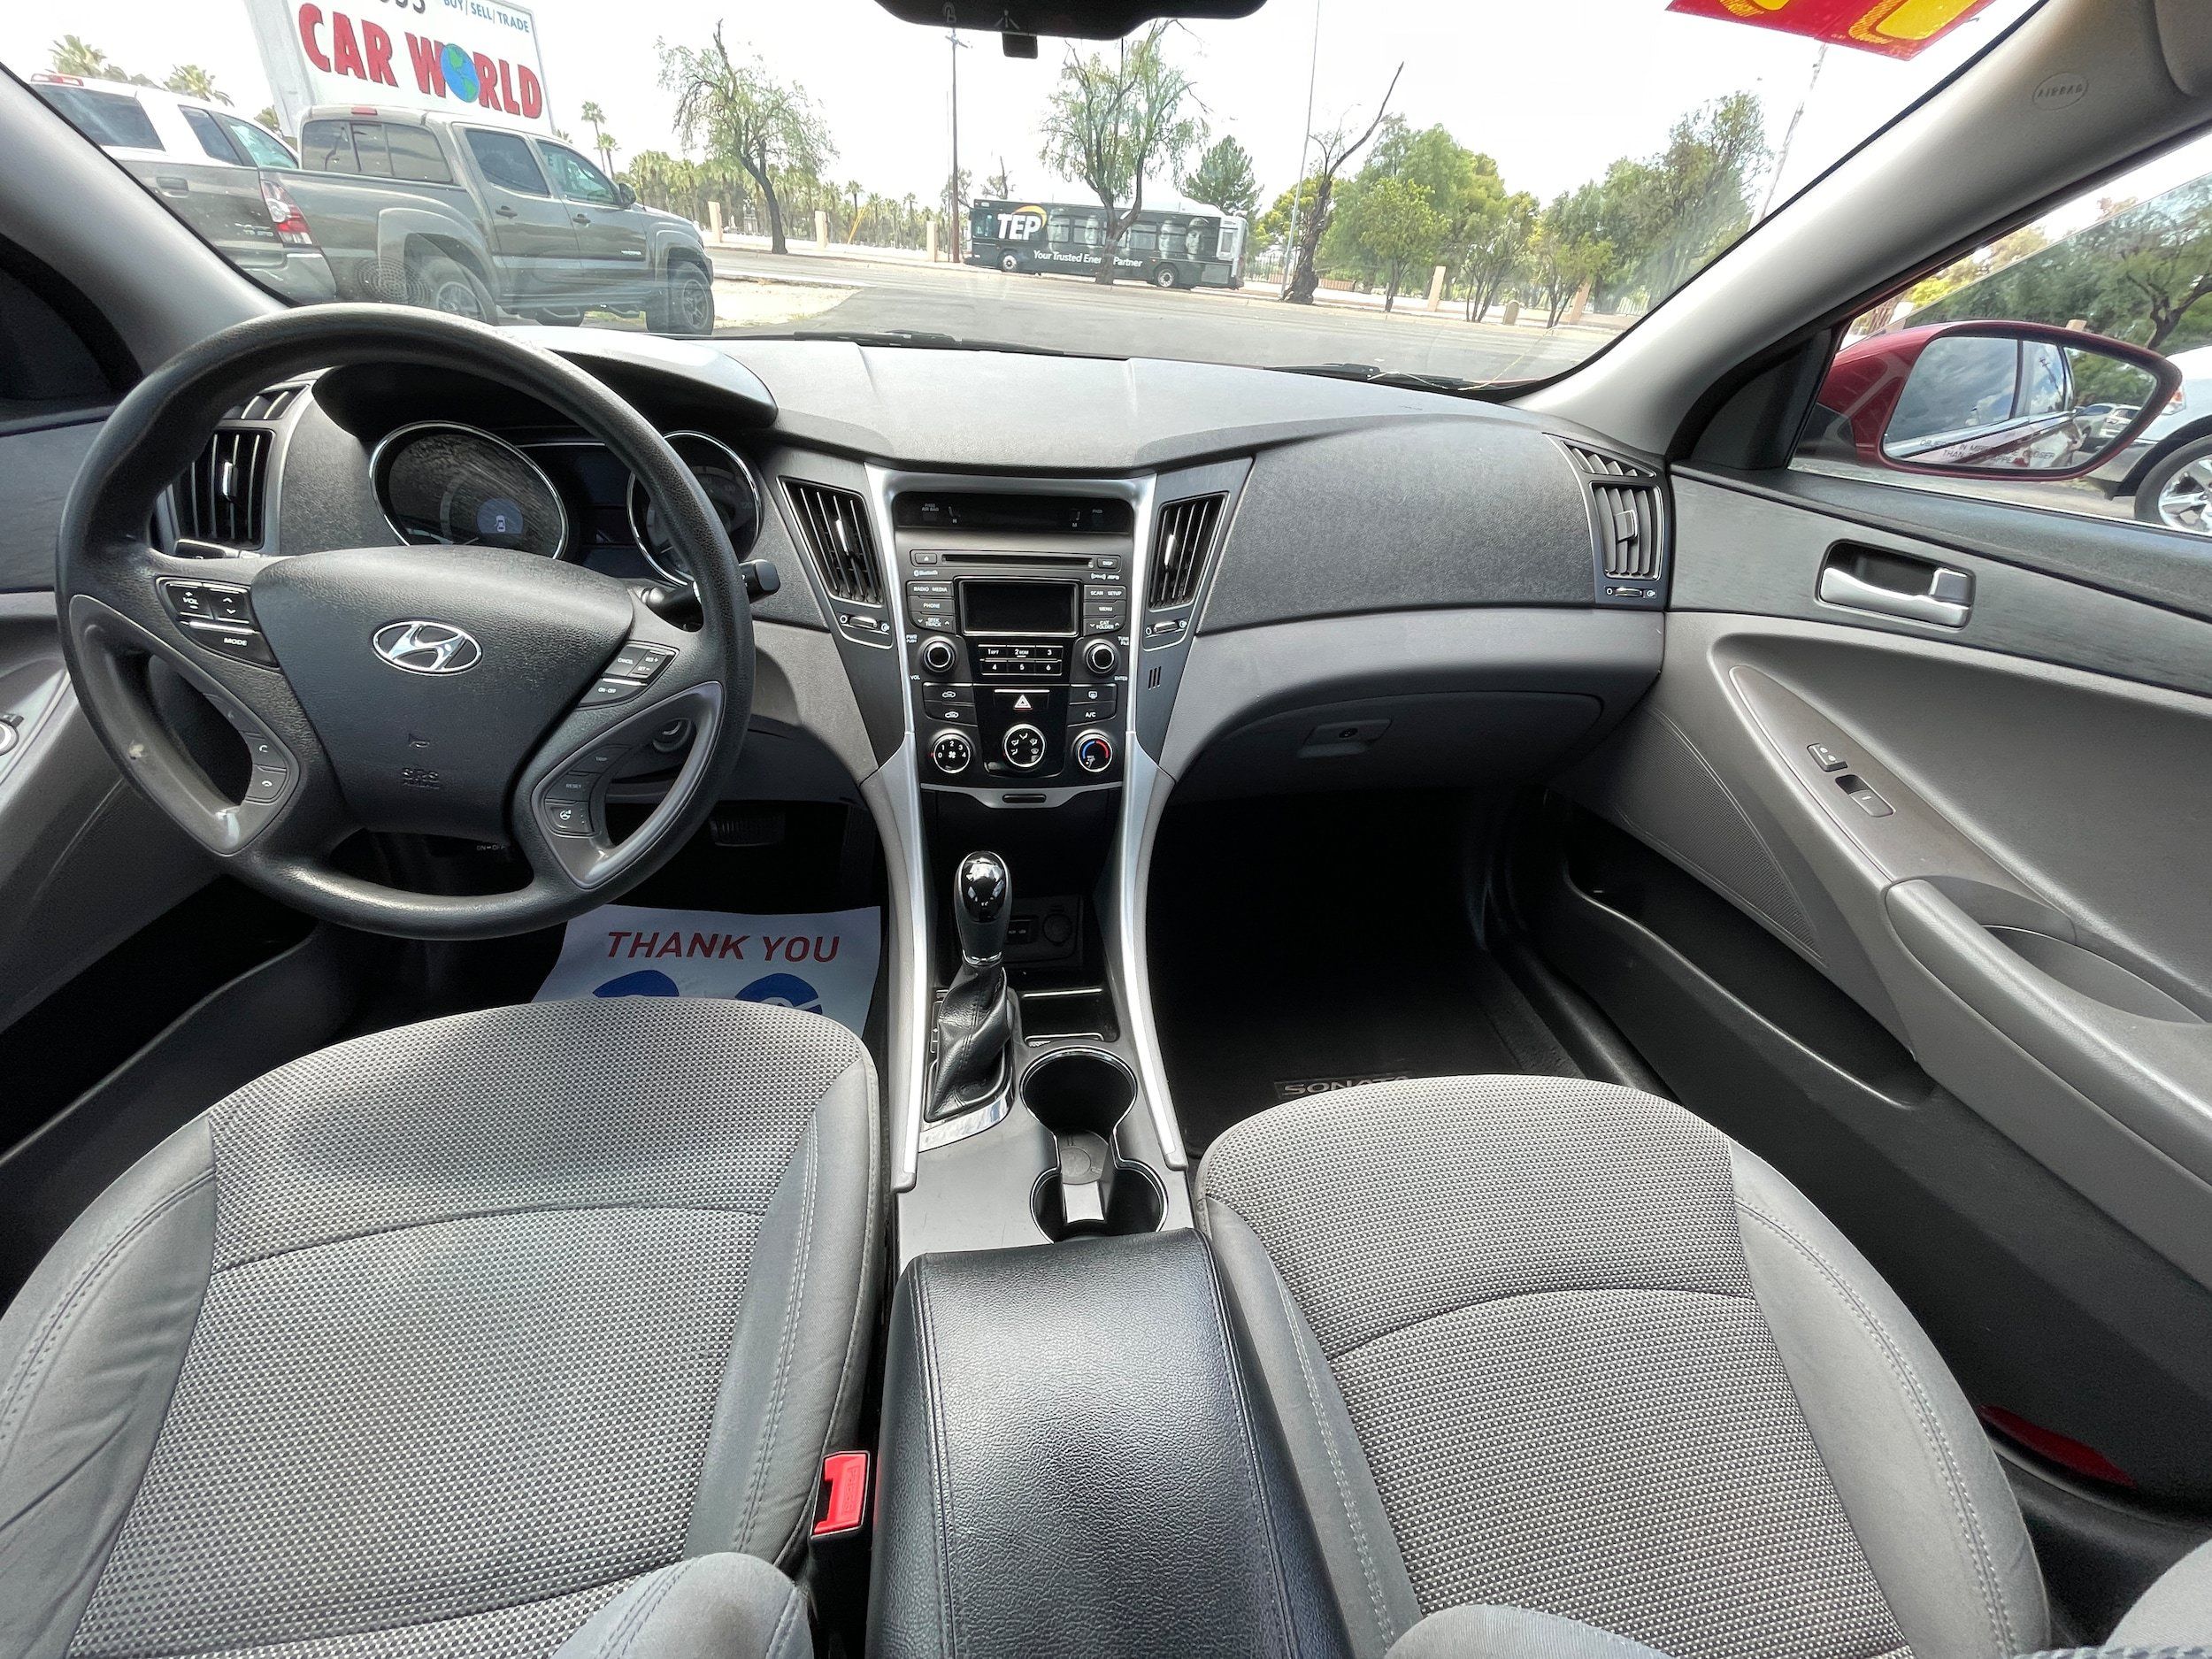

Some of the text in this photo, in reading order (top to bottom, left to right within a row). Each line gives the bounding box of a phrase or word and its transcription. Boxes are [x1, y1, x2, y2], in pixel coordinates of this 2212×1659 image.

[496, 11, 530, 33] TRADE
[299, 3, 542, 119] CAR WORLD
[997, 213, 1041, 241] TEP
[1033, 250, 1143, 267] Your Trusted Ener Partner
[223, 637, 248, 647] MODE
[608, 932, 840, 963] THANK YOU
